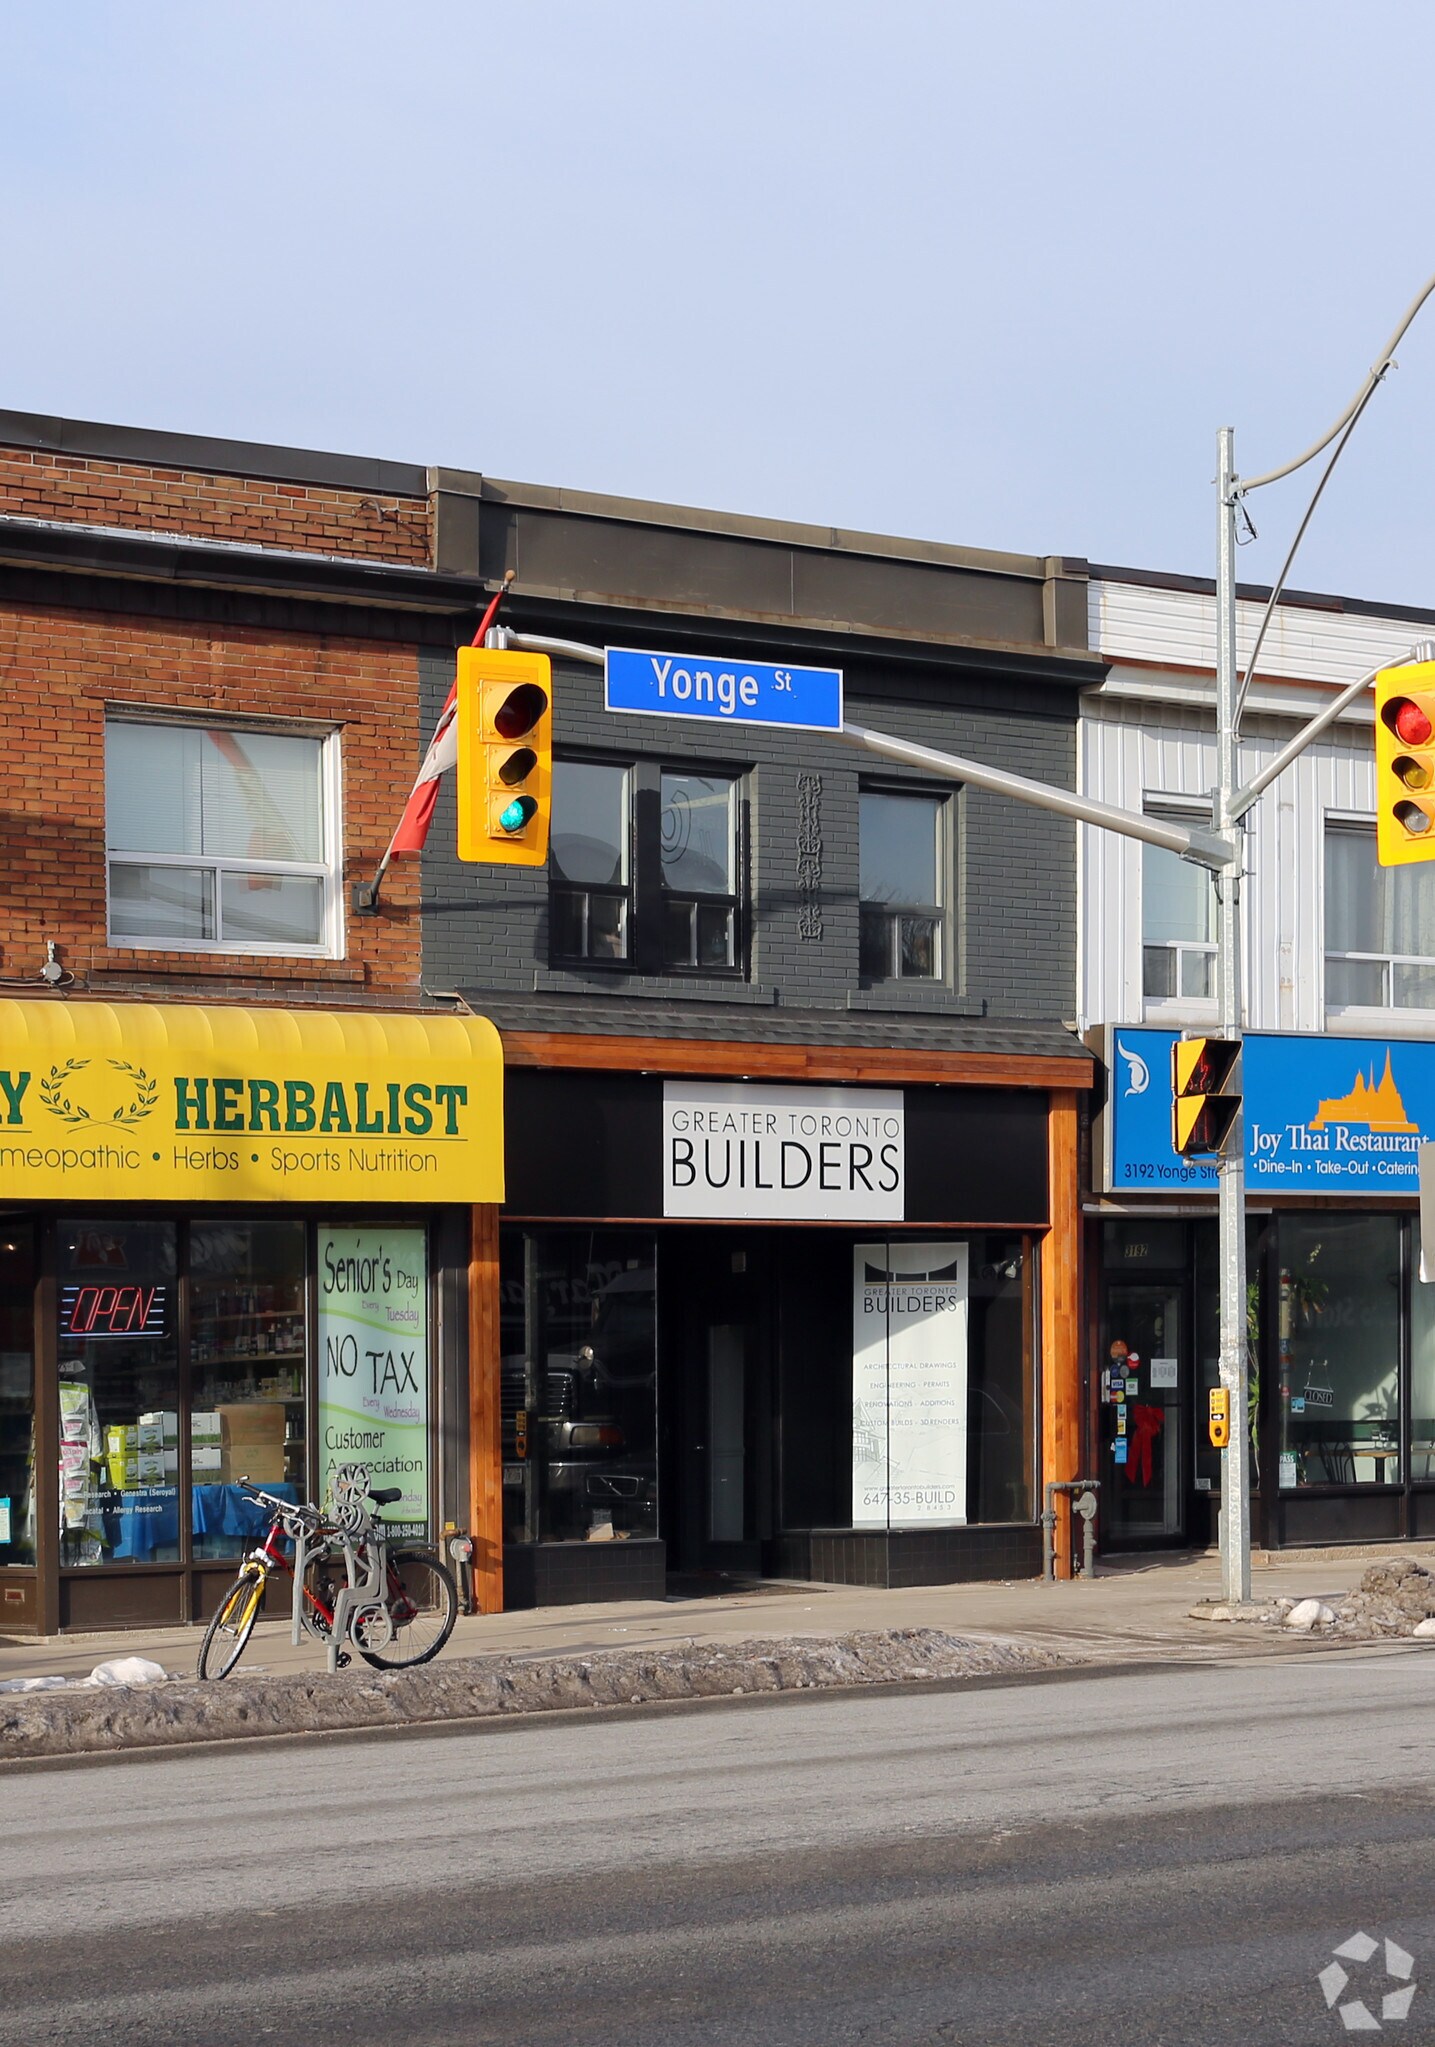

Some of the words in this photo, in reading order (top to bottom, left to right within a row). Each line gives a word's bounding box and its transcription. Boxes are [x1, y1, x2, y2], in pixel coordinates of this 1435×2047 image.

[651, 658, 759, 715] Yonge
[774, 670, 792, 691] St
[174, 1077, 467, 1135] HERBALIST
[672, 1110, 777, 1134] GREATER
[789, 1115, 900, 1138] TORONTO
[1250, 1124, 1282, 1157] Joy
[1285, 1124, 1329, 1151] Thai
[174, 1146, 239, 1170] Herbs
[271, 1147, 340, 1175] Sports
[349, 1148, 437, 1172] Nutrition
[672, 1137, 900, 1192] BUILDERS
[1125, 1164, 1154, 1178] 3192
[1156, 1164, 1196, 1182] Yonge
[1258, 1159, 1302, 1173] Dine-In
[1315, 1160, 1369, 1175] Take-Out
[1377, 1160, 1420, 1176] Caterin
[1125, 1244, 1148, 1257] 3192
[323, 1238, 391, 1294] Senior's
[397, 1270, 418, 1299] Day
[864, 1287, 907, 1296] GREATER
[911, 1287, 957, 1295] TORONTO
[864, 1296, 956, 1313] BUILDERS
[70, 1287, 154, 1331] OPEN
[362, 1301, 379, 1313] Every
[385, 1301, 419, 1329] Tuesday
[327, 1334, 358, 1377] NO
[365, 1350, 418, 1394] TAX
[1304, 1389, 1332, 1404] CLOSED
[362, 1397, 380, 1412] Every
[383, 1400, 420, 1424] Wednesday
[325, 1426, 385, 1450] Customer
[1280, 1455, 1294, 1463] PASS
[113, 1505, 133, 1515] Allergy
[135, 1505, 162, 1513] Research
[863, 1491, 956, 1506] 647-35-BUILD
